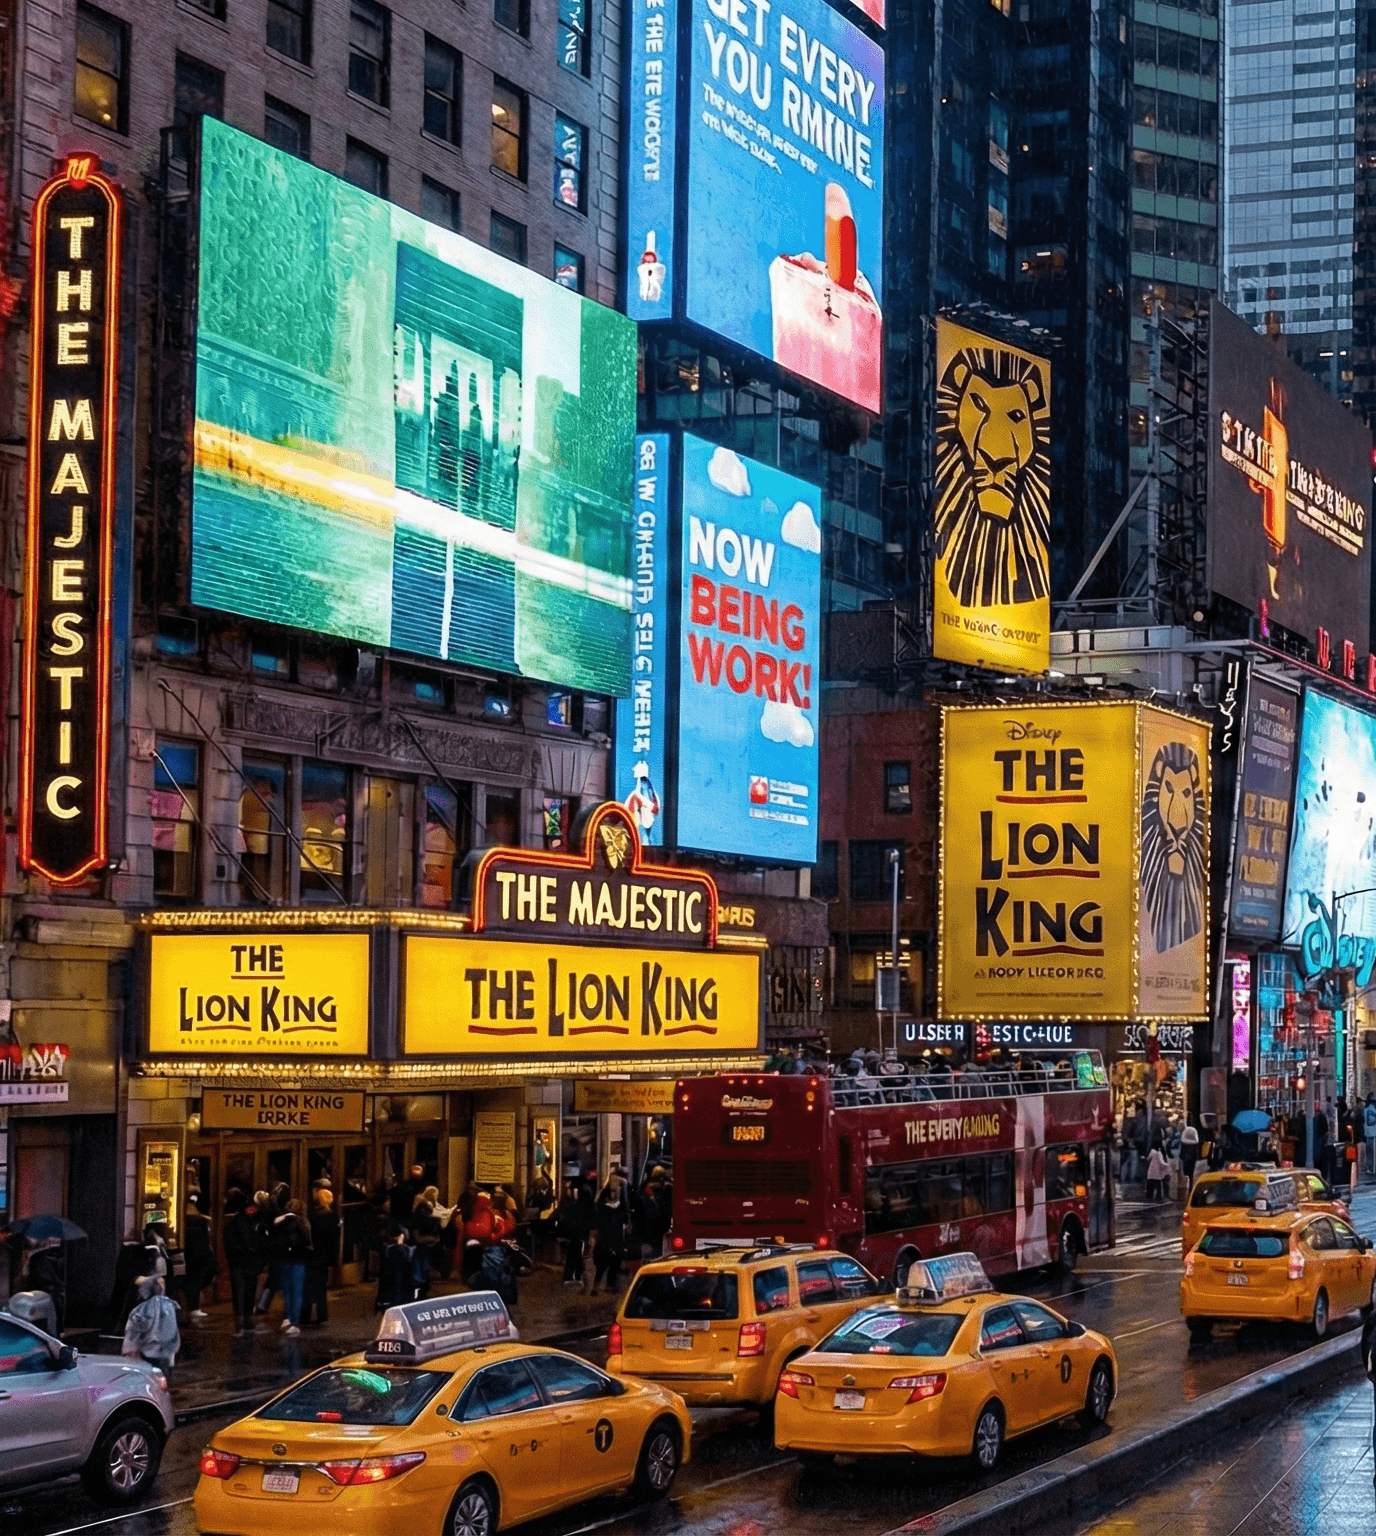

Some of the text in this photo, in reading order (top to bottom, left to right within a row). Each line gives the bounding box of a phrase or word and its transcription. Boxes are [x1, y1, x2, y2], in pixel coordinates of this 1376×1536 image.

[645, 13, 665, 54] THE
[703, 19, 772, 111] YOU
[779, 13, 876, 127] EVERY
[56, 216, 95, 365] THE
[689, 514, 775, 587] NOW
[46, 398, 95, 820] MAJESTIC
[690, 573, 805, 652] BEING
[687, 631, 812, 710] WORK!
[994, 748, 1085, 792] THE
[980, 810, 1100, 881] LION
[496, 871, 558, 924] THE
[568, 879, 702, 935] MAJESTIC
[975, 887, 1103, 958] KING
[230, 944, 285, 973] THE
[179, 985, 338, 1032] LION KING
[464, 957, 718, 1037] THE LION KING
[223, 1094, 345, 1110] THE LION KING
[904, 1120, 927, 1145] THE
